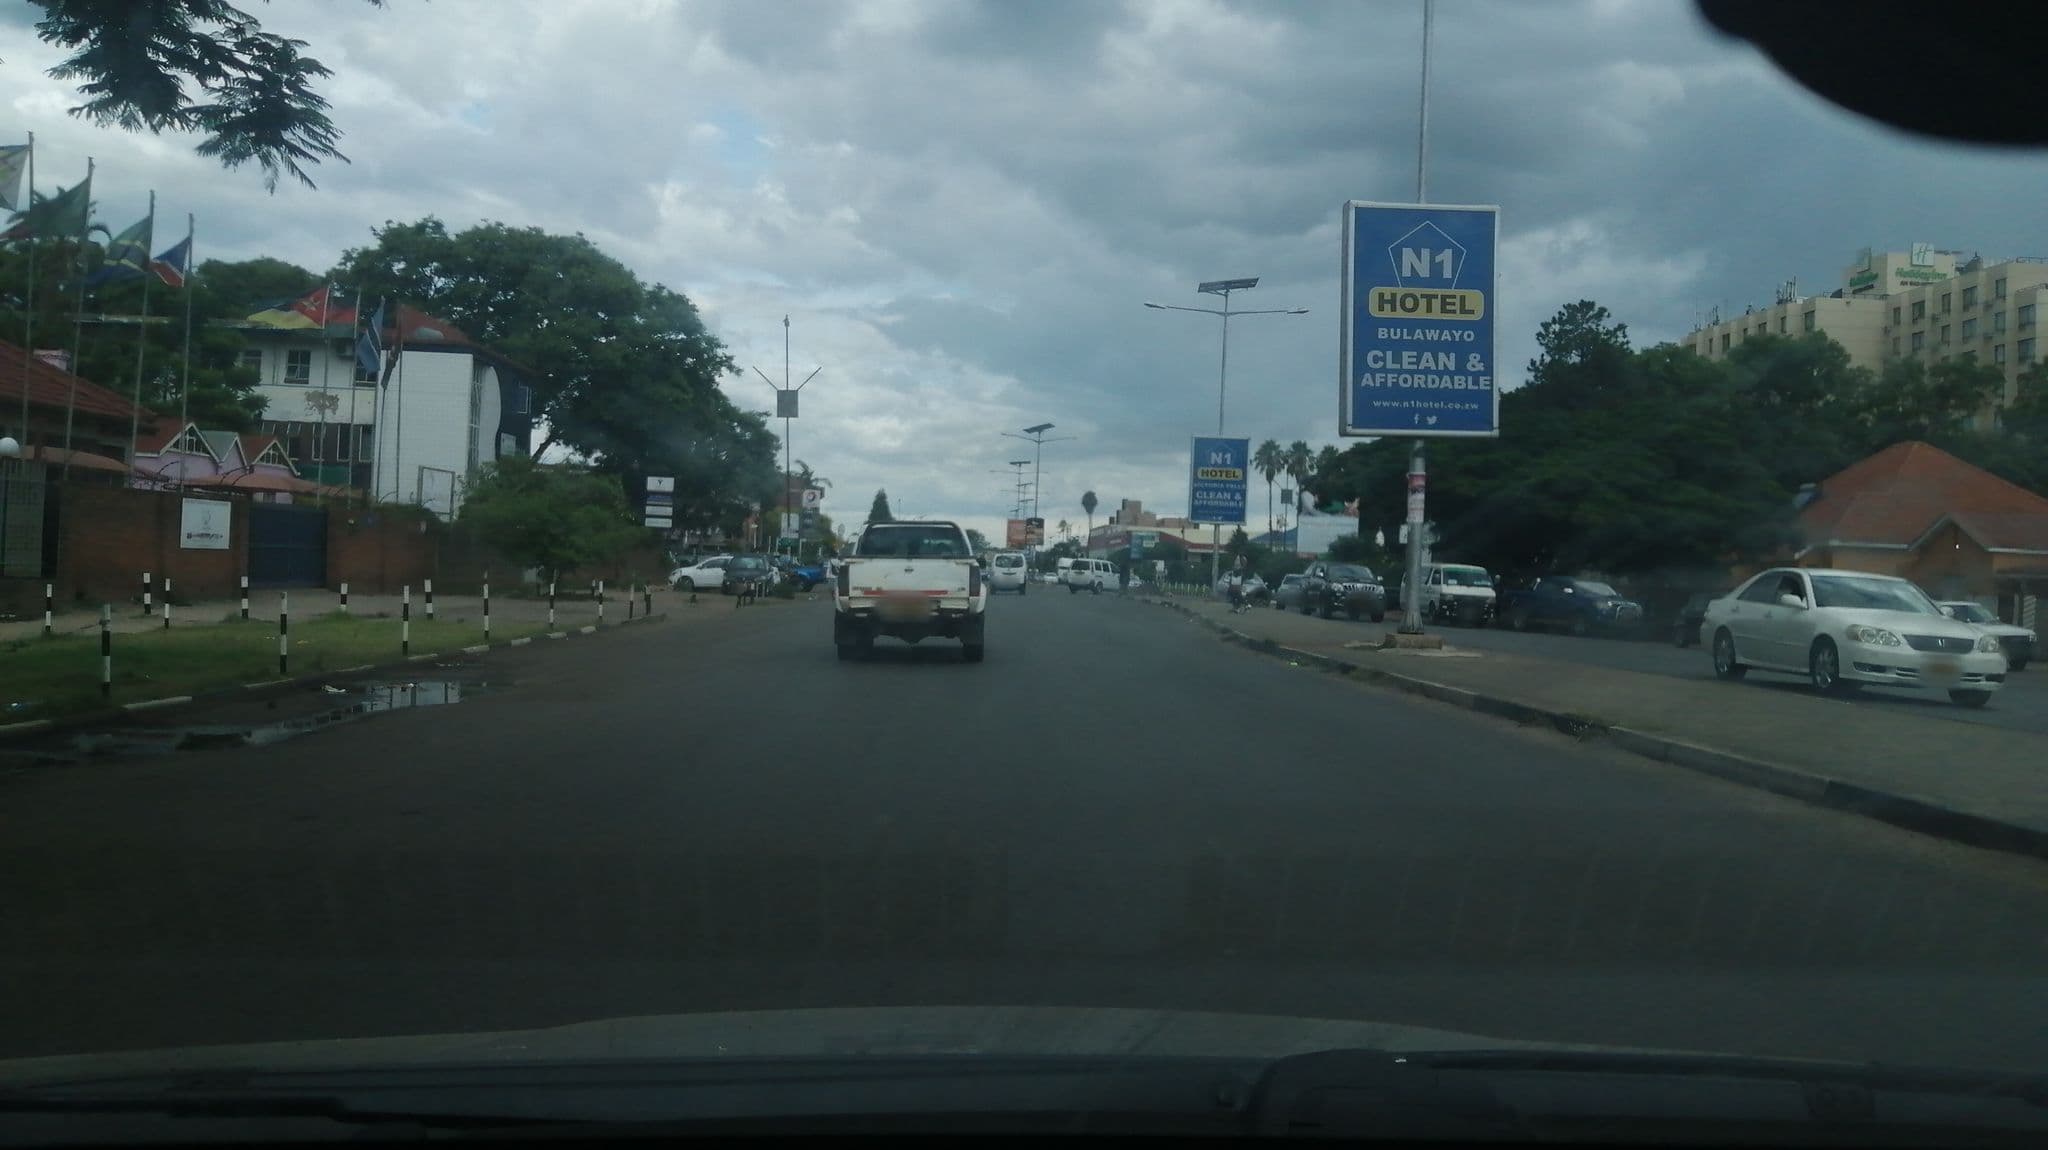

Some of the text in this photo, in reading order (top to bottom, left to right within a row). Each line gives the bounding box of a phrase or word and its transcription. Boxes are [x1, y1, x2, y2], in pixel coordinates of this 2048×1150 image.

[1402, 247, 1454, 279] N1
[1377, 292, 1475, 315] HOTEL
[1377, 327, 1475, 342] BULAWAYO
[1366, 350, 1485, 372] CLEAN &
[1360, 372, 1492, 390] AFFORDABLE
[1373, 399, 1479, 410] www.n1hotel.co.zw
[1210, 451, 1232, 465] N1
[1200, 469, 1239, 479] HOTEL
[1196, 490, 1242, 501] CLEAN &
